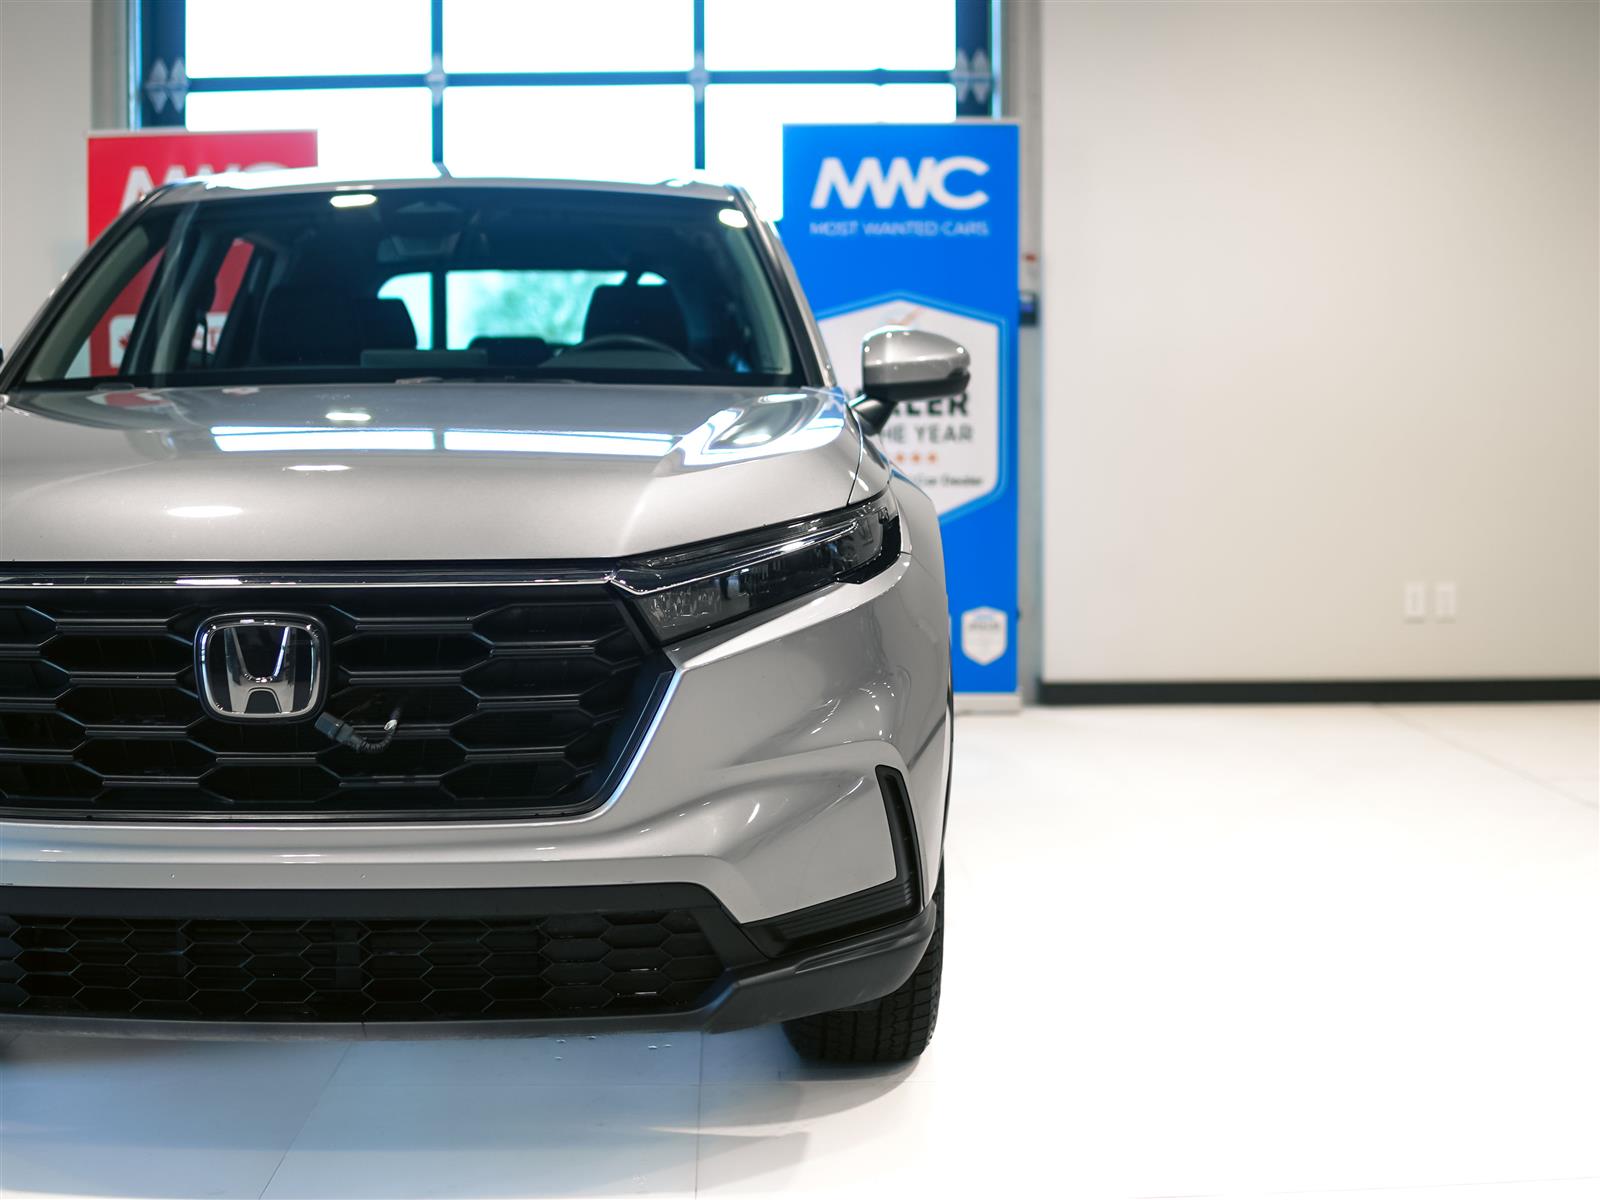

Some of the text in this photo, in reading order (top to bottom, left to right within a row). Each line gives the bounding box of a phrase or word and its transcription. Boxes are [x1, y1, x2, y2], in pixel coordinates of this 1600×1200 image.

[810, 156, 989, 210] MWC
[809, 221, 989, 236] MOST WANTED CARS
[915, 424, 974, 443] YEAR
